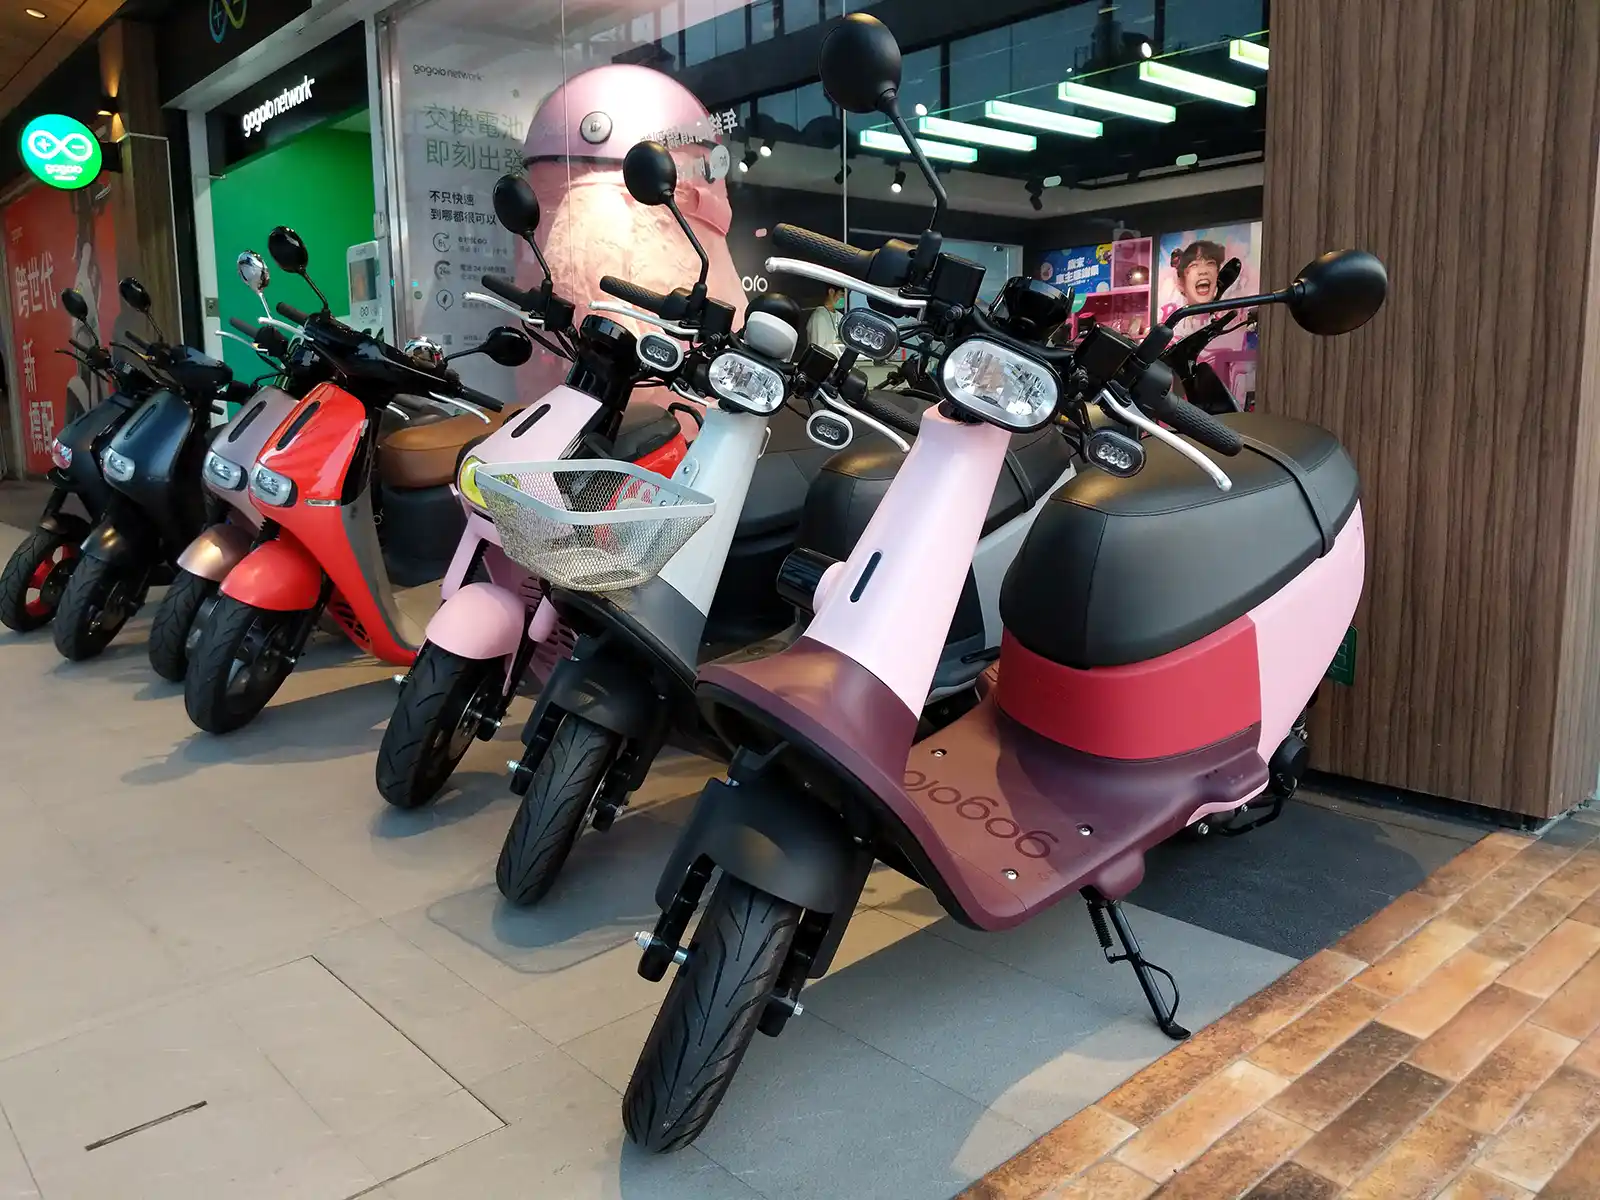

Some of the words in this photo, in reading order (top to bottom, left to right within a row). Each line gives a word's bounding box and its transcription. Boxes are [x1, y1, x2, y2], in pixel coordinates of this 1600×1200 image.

[412, 64, 446, 77] gogoro
[447, 68, 482, 81] network
[242, 99, 274, 138] gogoro
[273, 75, 314, 117] network
[423, 103, 524, 141] 交換電池
[426, 138, 525, 176] 即刻出發
[428, 189, 475, 206] 不只快速
[430, 207, 497, 226] 到哪都很可以
[15, 250, 57, 318] 跨世代
[22, 338, 37, 393] 新
[904, 770, 1059, 858] gogoro
